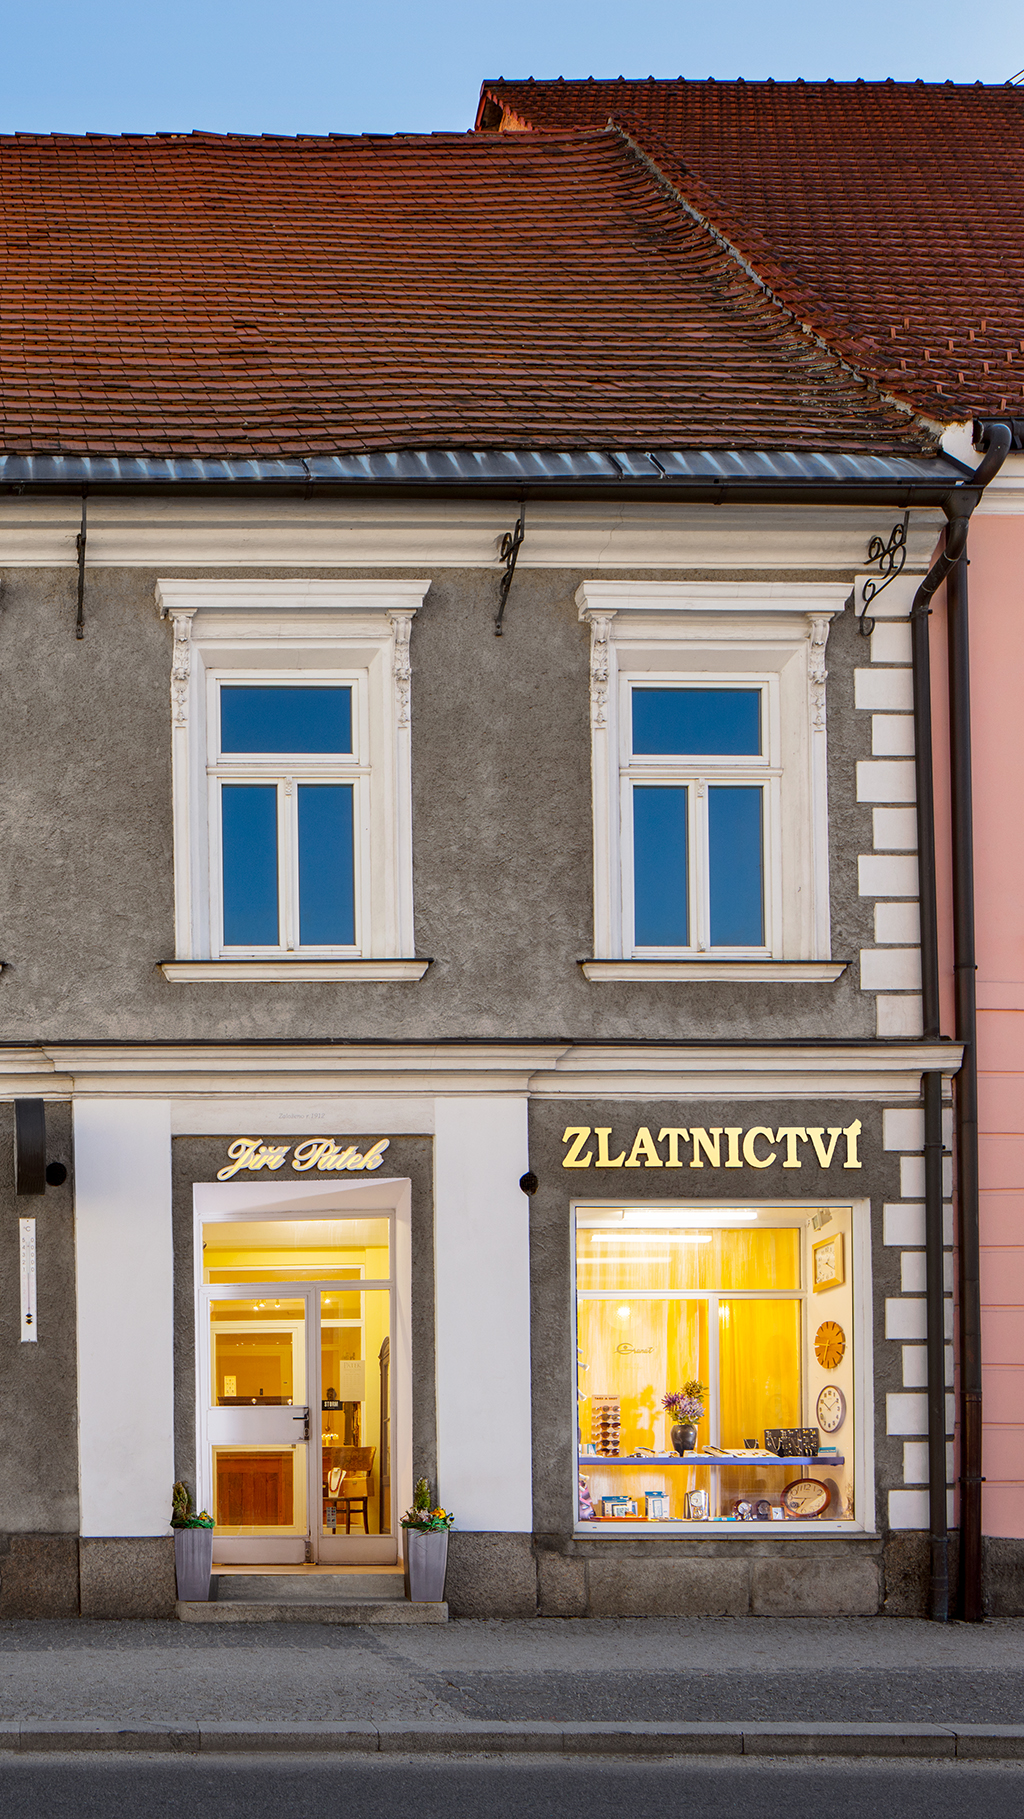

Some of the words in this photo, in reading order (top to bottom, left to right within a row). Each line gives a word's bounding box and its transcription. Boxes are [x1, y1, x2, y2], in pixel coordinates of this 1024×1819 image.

[217, 1138, 291, 1181] Jiří
[292, 1138, 390, 1171] Pátek
[562, 1119, 863, 1168] ZLATNICTVÍ
